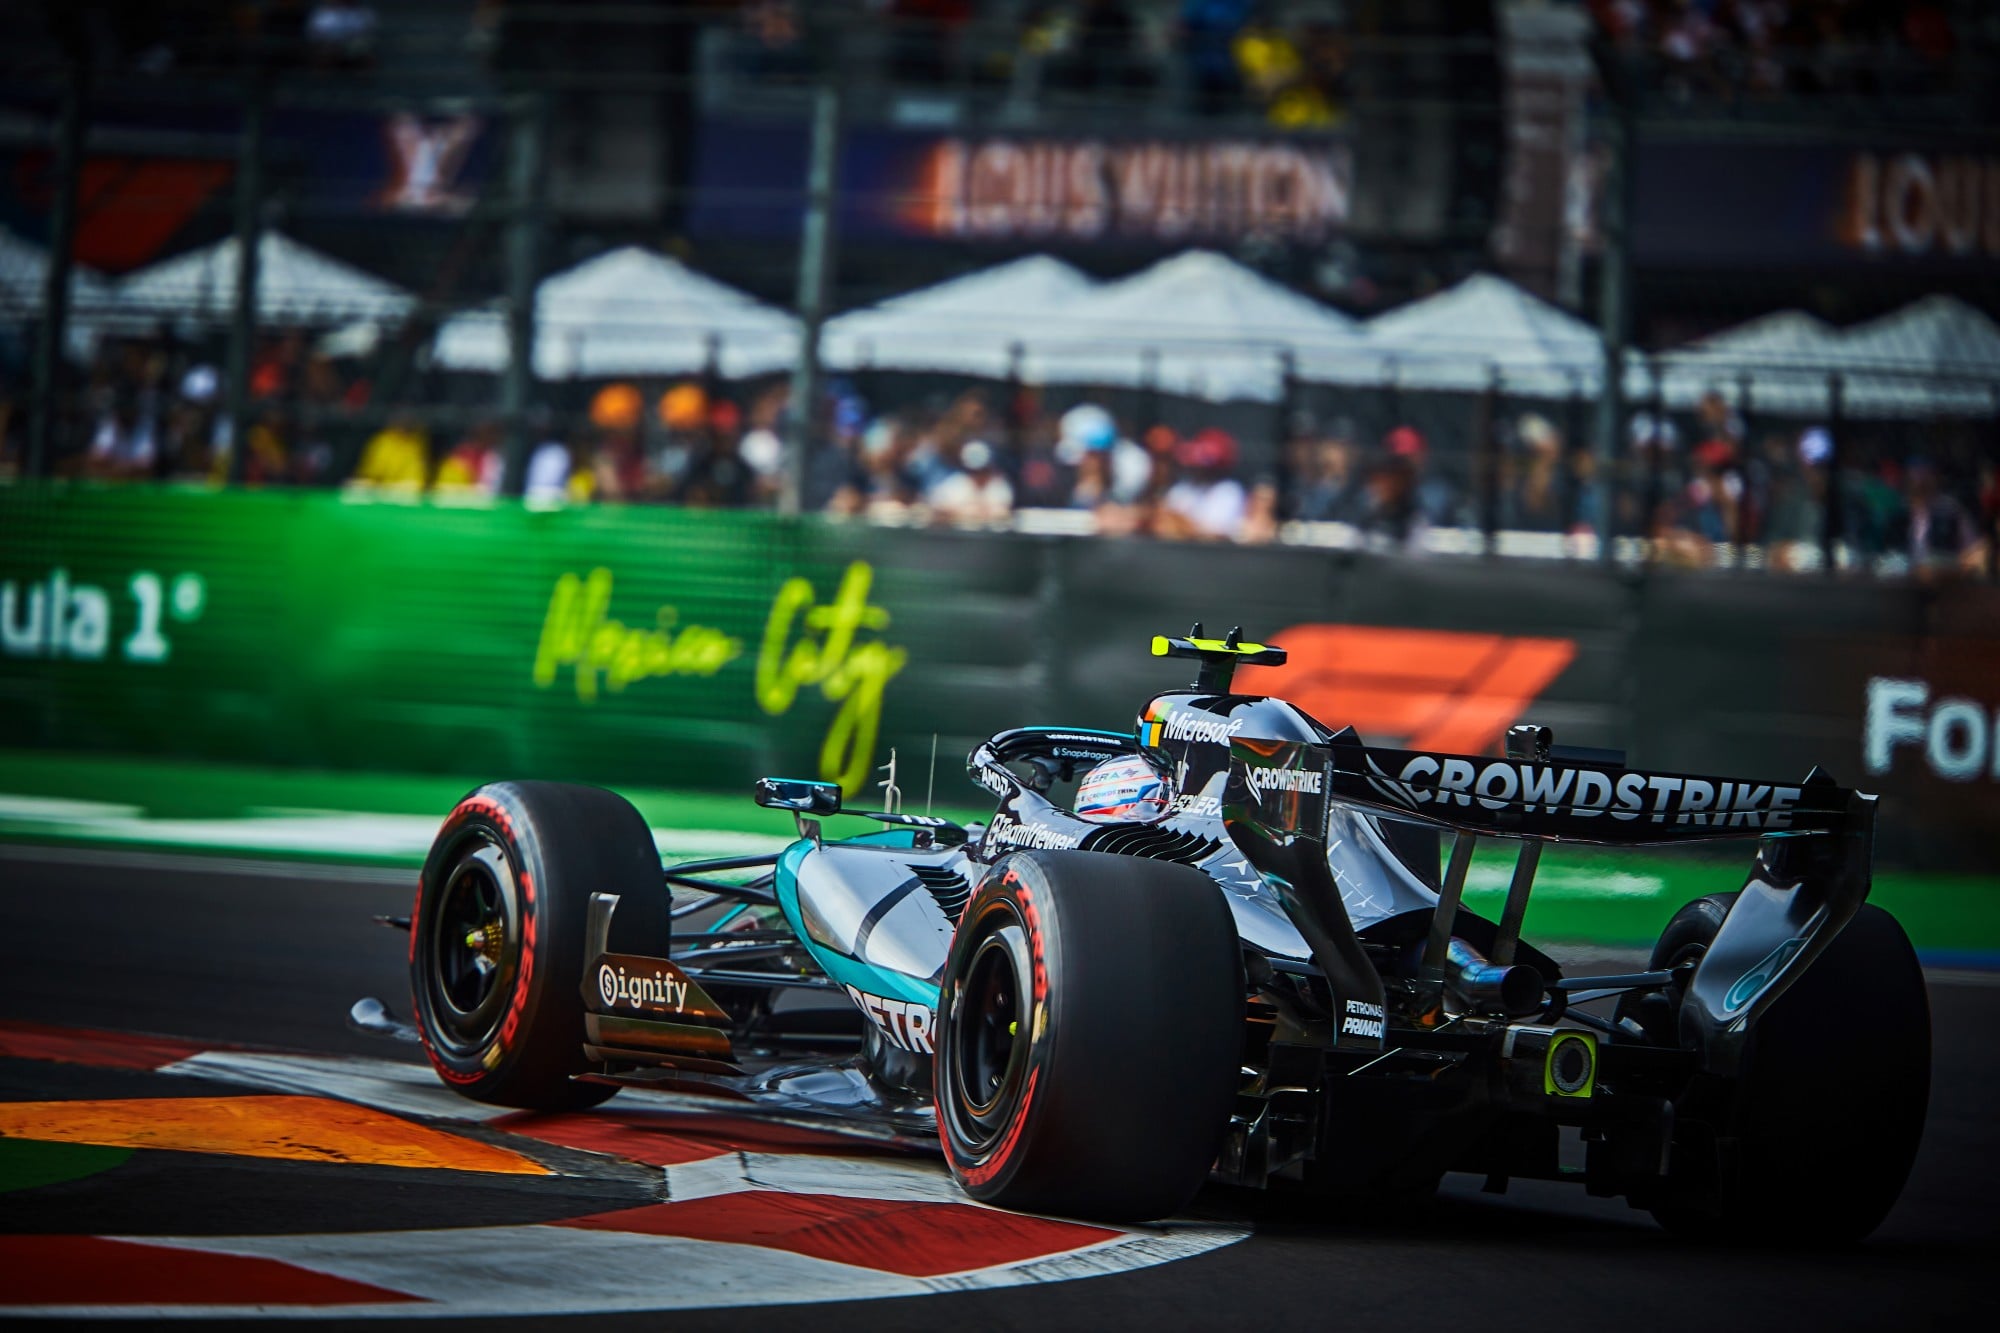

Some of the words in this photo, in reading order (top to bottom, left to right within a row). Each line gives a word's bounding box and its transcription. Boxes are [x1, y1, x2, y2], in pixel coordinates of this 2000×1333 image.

[755, 559, 908, 798] City
[1163, 711, 1243, 747] Microsoft
[1863, 675, 2000, 781] Fo
[1061, 747, 1113, 761] Snapdragon
[981, 766, 1003, 792] AMD
[1253, 766, 1322, 794] CROWDSTRIKE
[1401, 755, 1801, 828] CROWDSTRIKE
[998, 817, 1080, 851] TeamViewer
[598, 964, 688, 1013] Signify
[845, 982, 937, 1054] PETR
[1346, 999, 1383, 1018] PETRONAS
